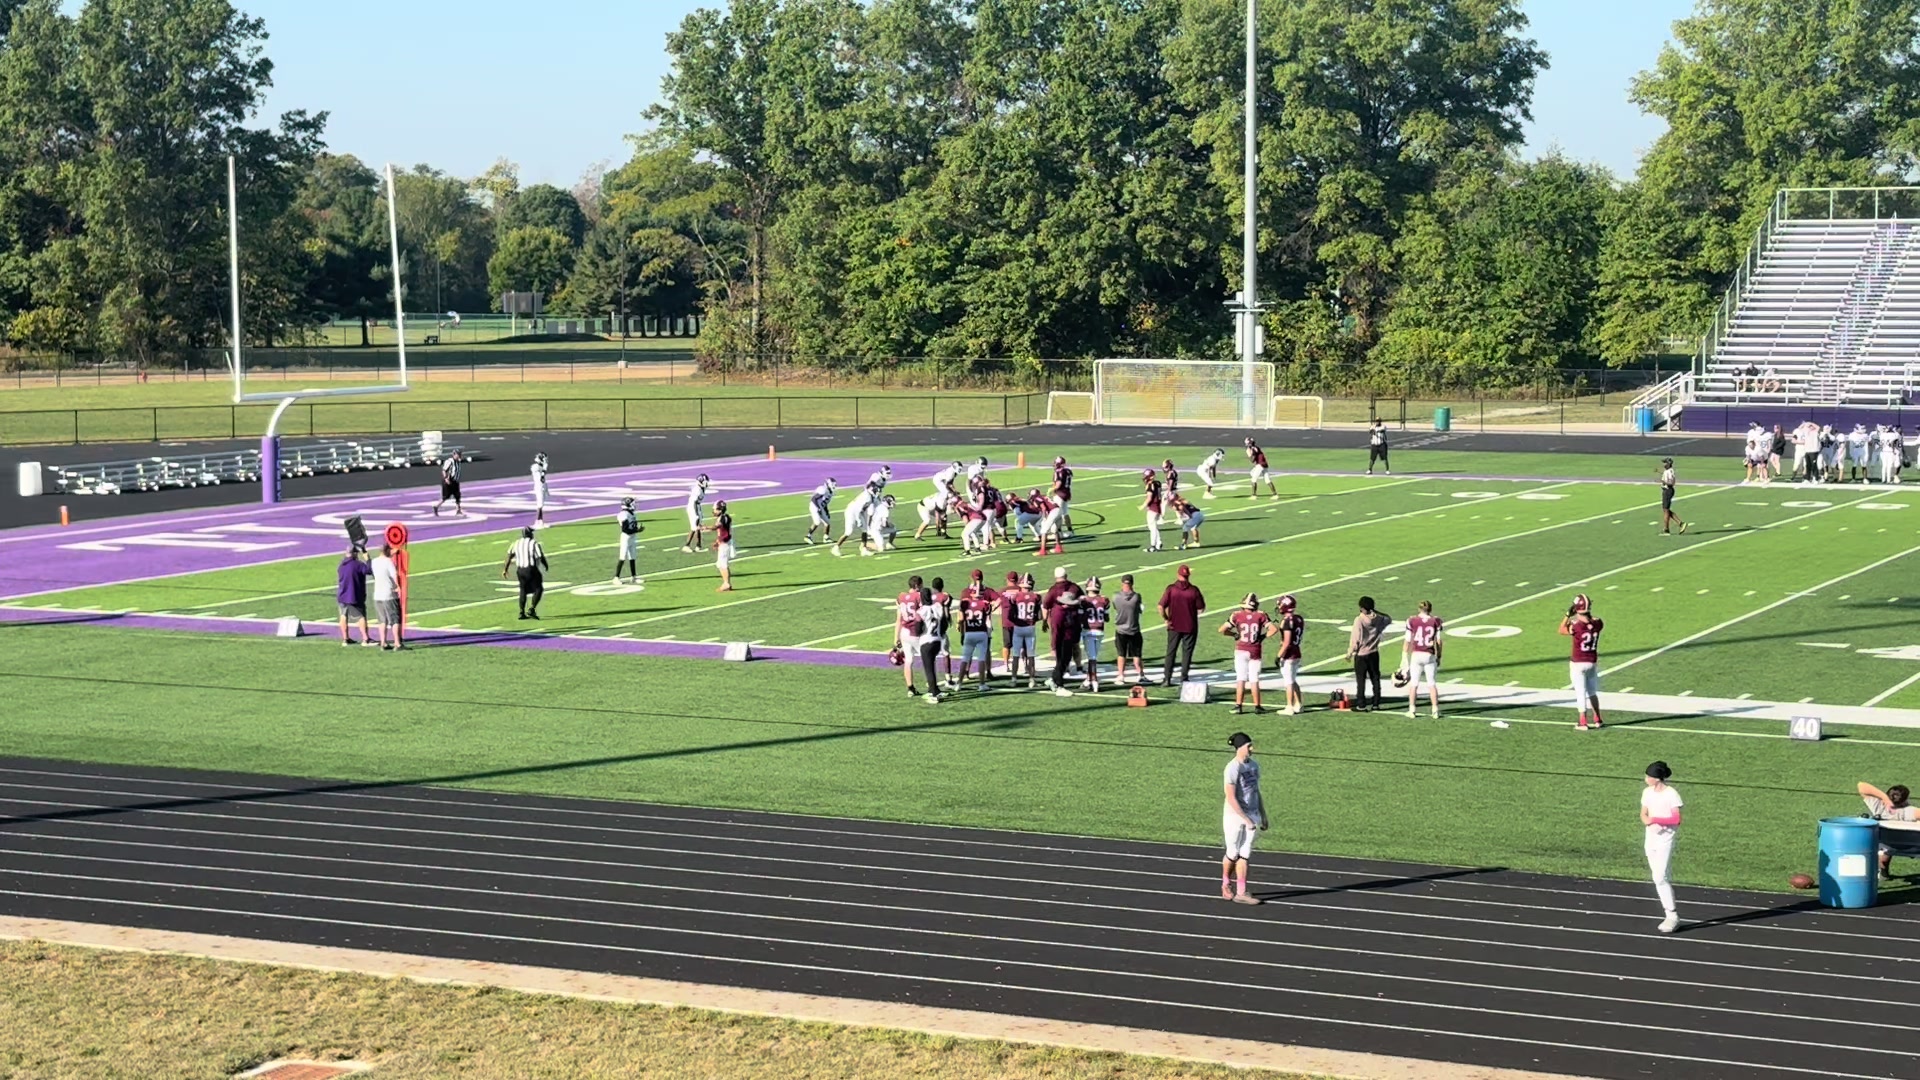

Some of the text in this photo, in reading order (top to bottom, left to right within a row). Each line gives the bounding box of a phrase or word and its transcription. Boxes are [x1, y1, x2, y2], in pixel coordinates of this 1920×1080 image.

[1017, 601, 1036, 620] 89
[1086, 607, 1105, 623] 36
[1239, 622, 1259, 644] 28
[1413, 625, 1435, 647] 42
[1580, 631, 1599, 651] 21
[1184, 683, 1204, 701] 30
[1793, 717, 1819, 738] 40
